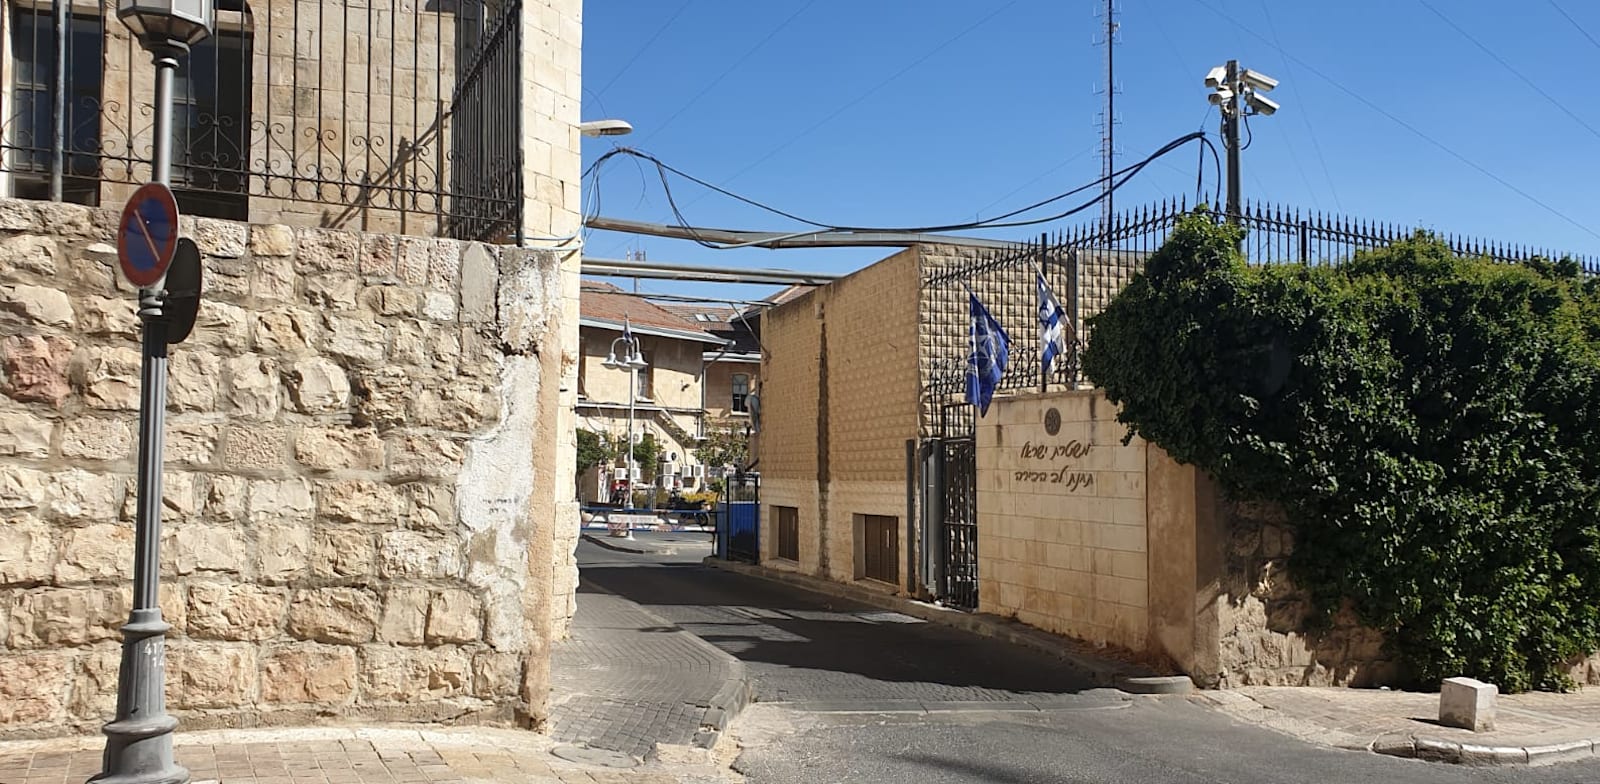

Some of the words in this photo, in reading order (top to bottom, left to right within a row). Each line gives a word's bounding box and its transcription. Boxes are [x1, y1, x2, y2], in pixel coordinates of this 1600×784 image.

[1021, 441, 1048, 459] ישראל
[1049, 440, 1091, 460] משטרת
[1015, 471, 1047, 482] הבירה
[1050, 465, 1069, 483] לב
[1066, 473, 1093, 492] תחנת
